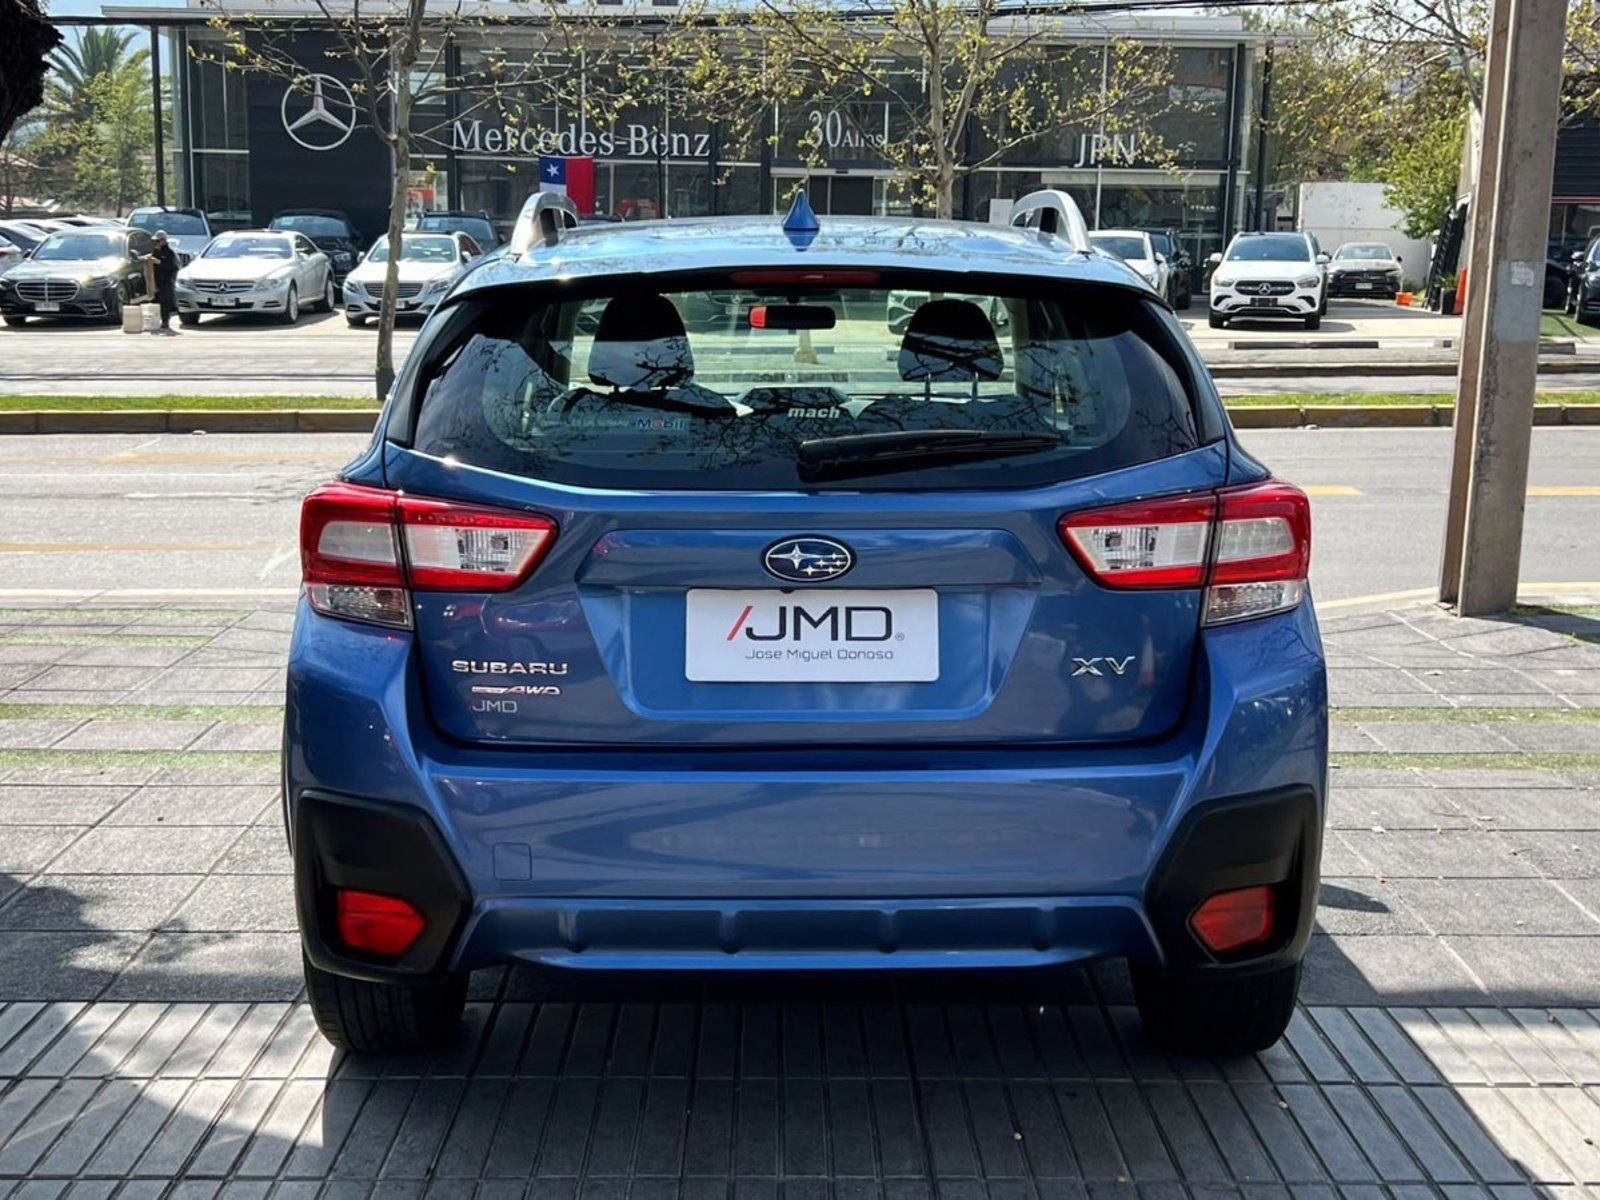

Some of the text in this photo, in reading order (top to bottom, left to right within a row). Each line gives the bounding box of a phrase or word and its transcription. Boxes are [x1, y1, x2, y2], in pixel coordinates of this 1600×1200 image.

[452, 120, 710, 157] Mercedes-Benz
[787, 406, 841, 419] mach
[745, 649, 894, 662] Jose Miguel Donoso
[451, 660, 568, 675] SUBARU
[1071, 655, 1137, 676] XV
[507, 685, 561, 695] AWD
